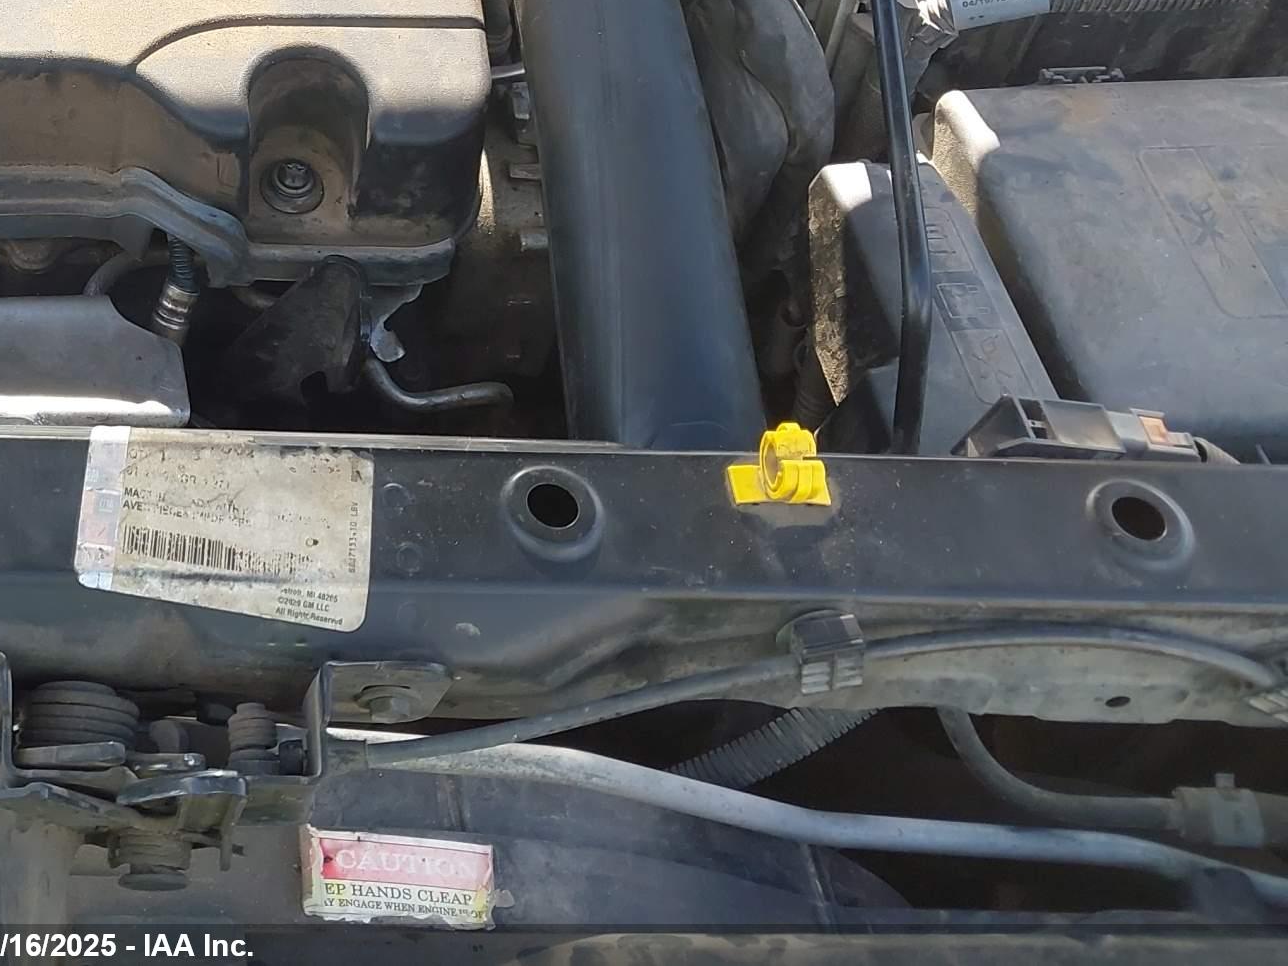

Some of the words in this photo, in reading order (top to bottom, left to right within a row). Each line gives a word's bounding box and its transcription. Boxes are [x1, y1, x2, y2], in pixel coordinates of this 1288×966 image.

[335, 848, 479, 879] CAUTION
[351, 884, 412, 901] HANDS
[337, 899, 382, 910] ENGAGE
[384, 901, 416, 913] WHEN
[418, 905, 458, 917] ENGINE
